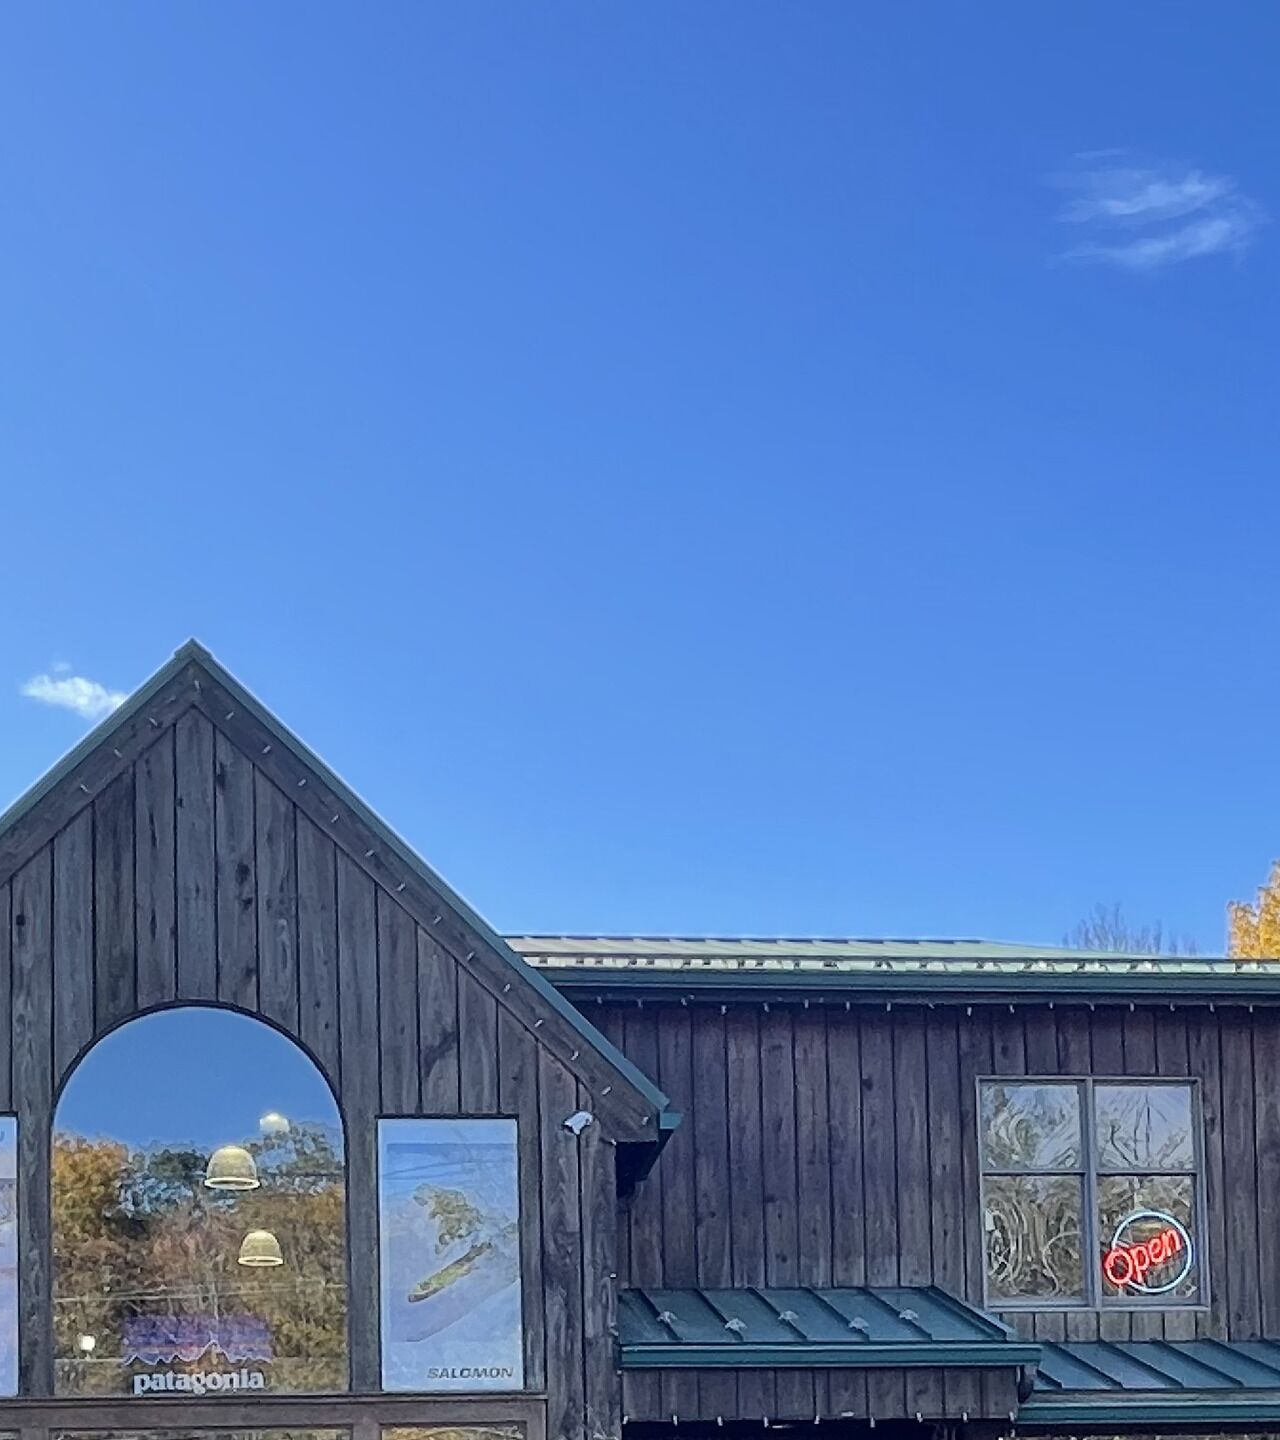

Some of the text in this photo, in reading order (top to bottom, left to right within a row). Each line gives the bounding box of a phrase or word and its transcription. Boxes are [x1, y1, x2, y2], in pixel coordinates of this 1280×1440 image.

[1103, 1227, 1184, 1285] Open
[133, 1368, 265, 1396] patagonia
[426, 1366, 514, 1380] SALOMON
